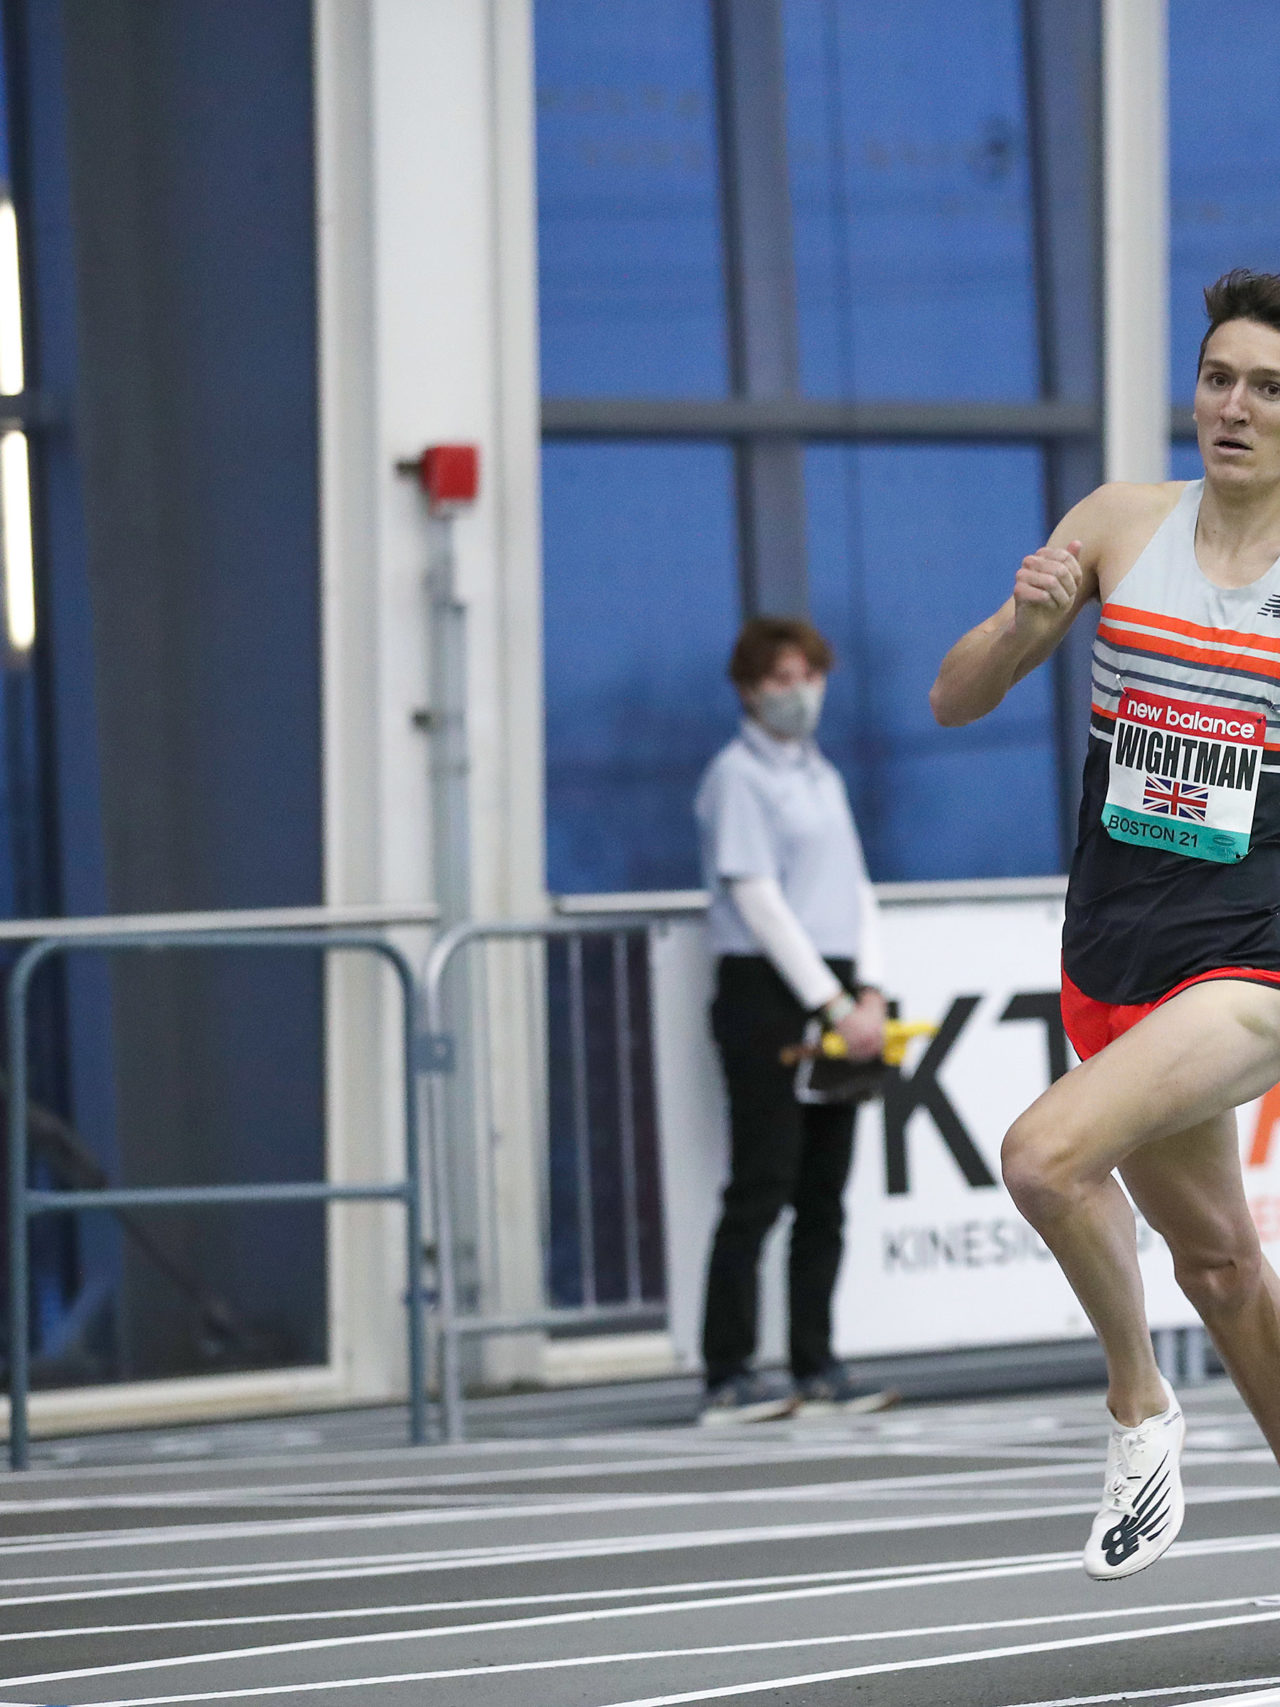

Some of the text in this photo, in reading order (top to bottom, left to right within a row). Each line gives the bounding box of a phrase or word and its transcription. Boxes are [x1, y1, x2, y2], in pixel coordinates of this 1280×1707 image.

[1126, 698, 1256, 739] new balance
[1114, 722, 1258, 792] WIGHTMAN
[1107, 814, 1199, 848] BOSTON 21
